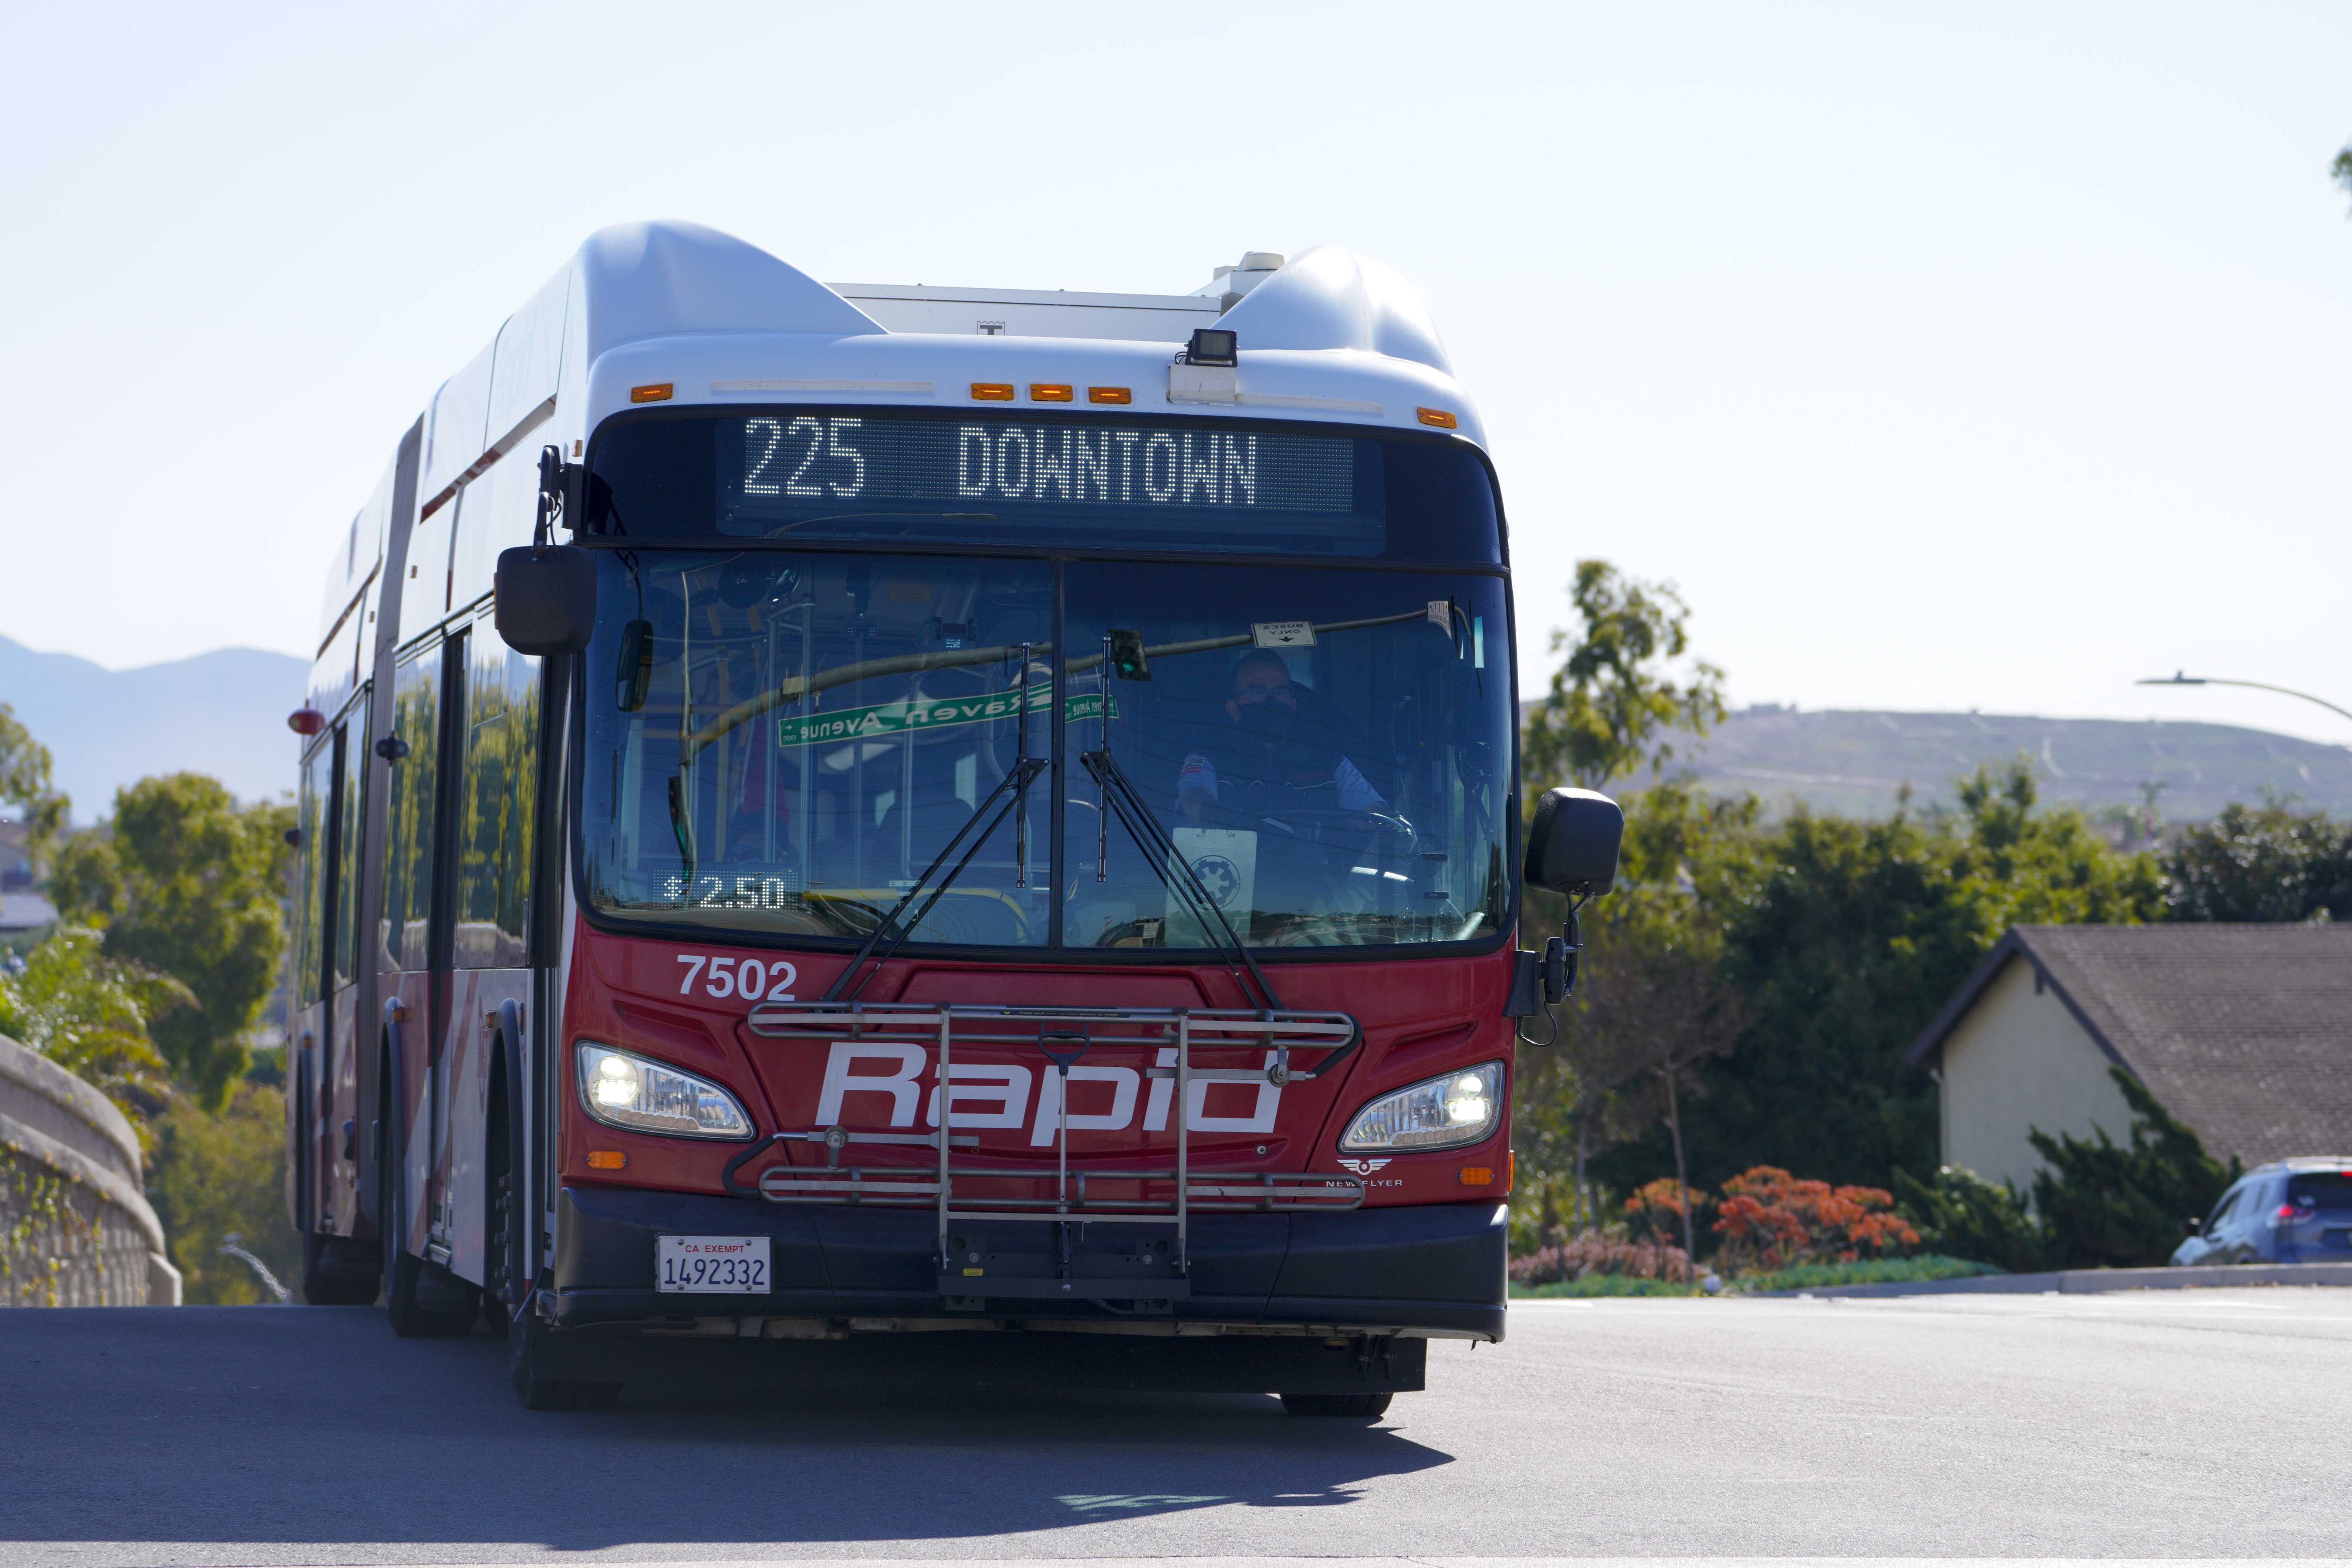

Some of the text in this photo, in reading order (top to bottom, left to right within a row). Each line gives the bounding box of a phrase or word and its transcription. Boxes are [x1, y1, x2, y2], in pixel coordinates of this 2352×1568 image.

[745, 416, 1256, 504] 225 DOWNTOWN
[677, 954, 797, 1001] 7502
[815, 1042, 1289, 1147] Rapid
[664, 1258, 765, 1286] 1492332
[685, 1245, 699, 1253] CA
